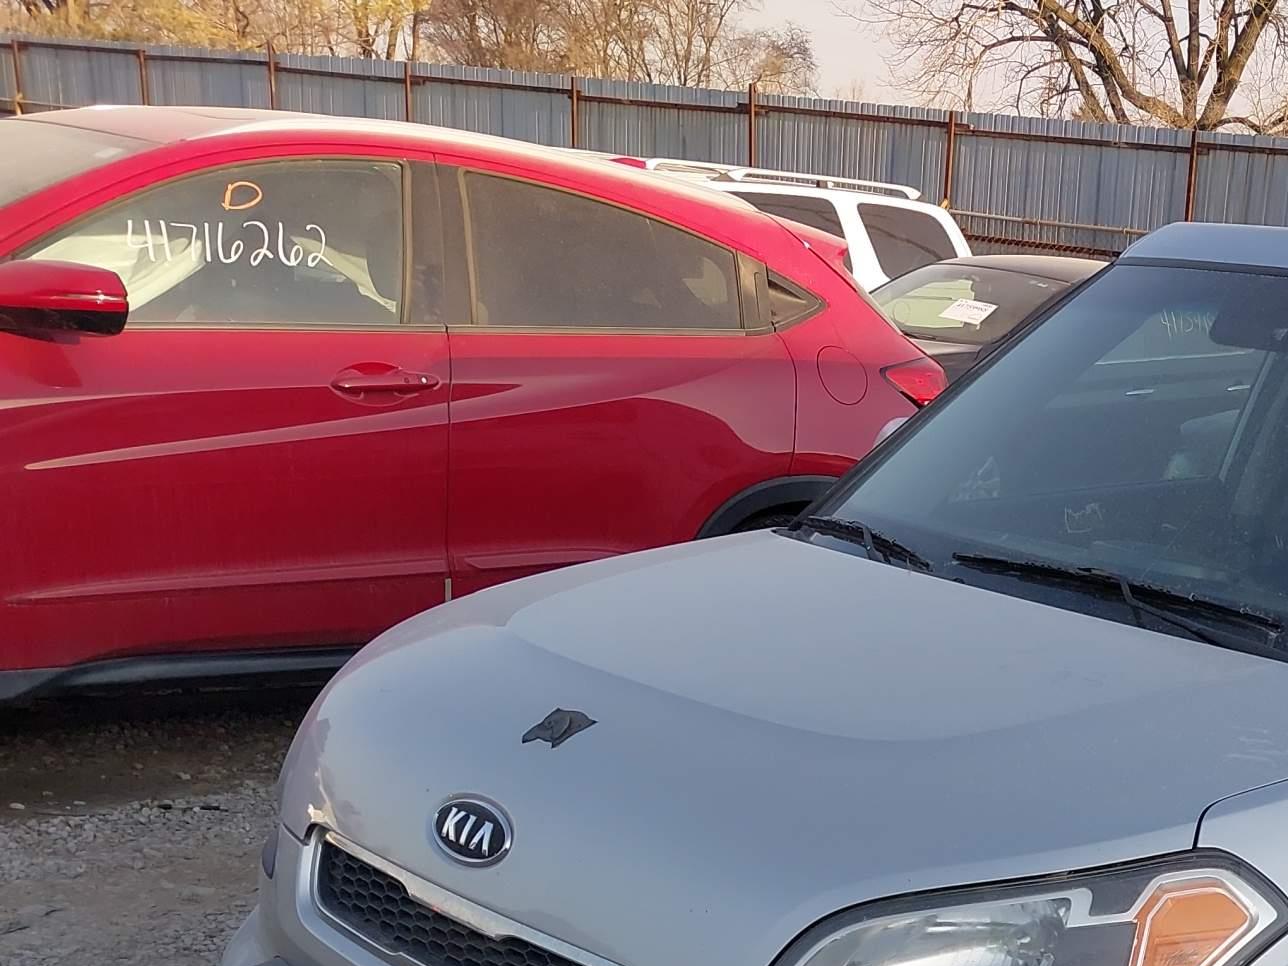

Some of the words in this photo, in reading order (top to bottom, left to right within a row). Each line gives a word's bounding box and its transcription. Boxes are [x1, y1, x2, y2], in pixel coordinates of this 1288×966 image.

[221, 181, 263, 210] D
[127, 219, 334, 267] 41716262
[441, 806, 494, 857] KIA
